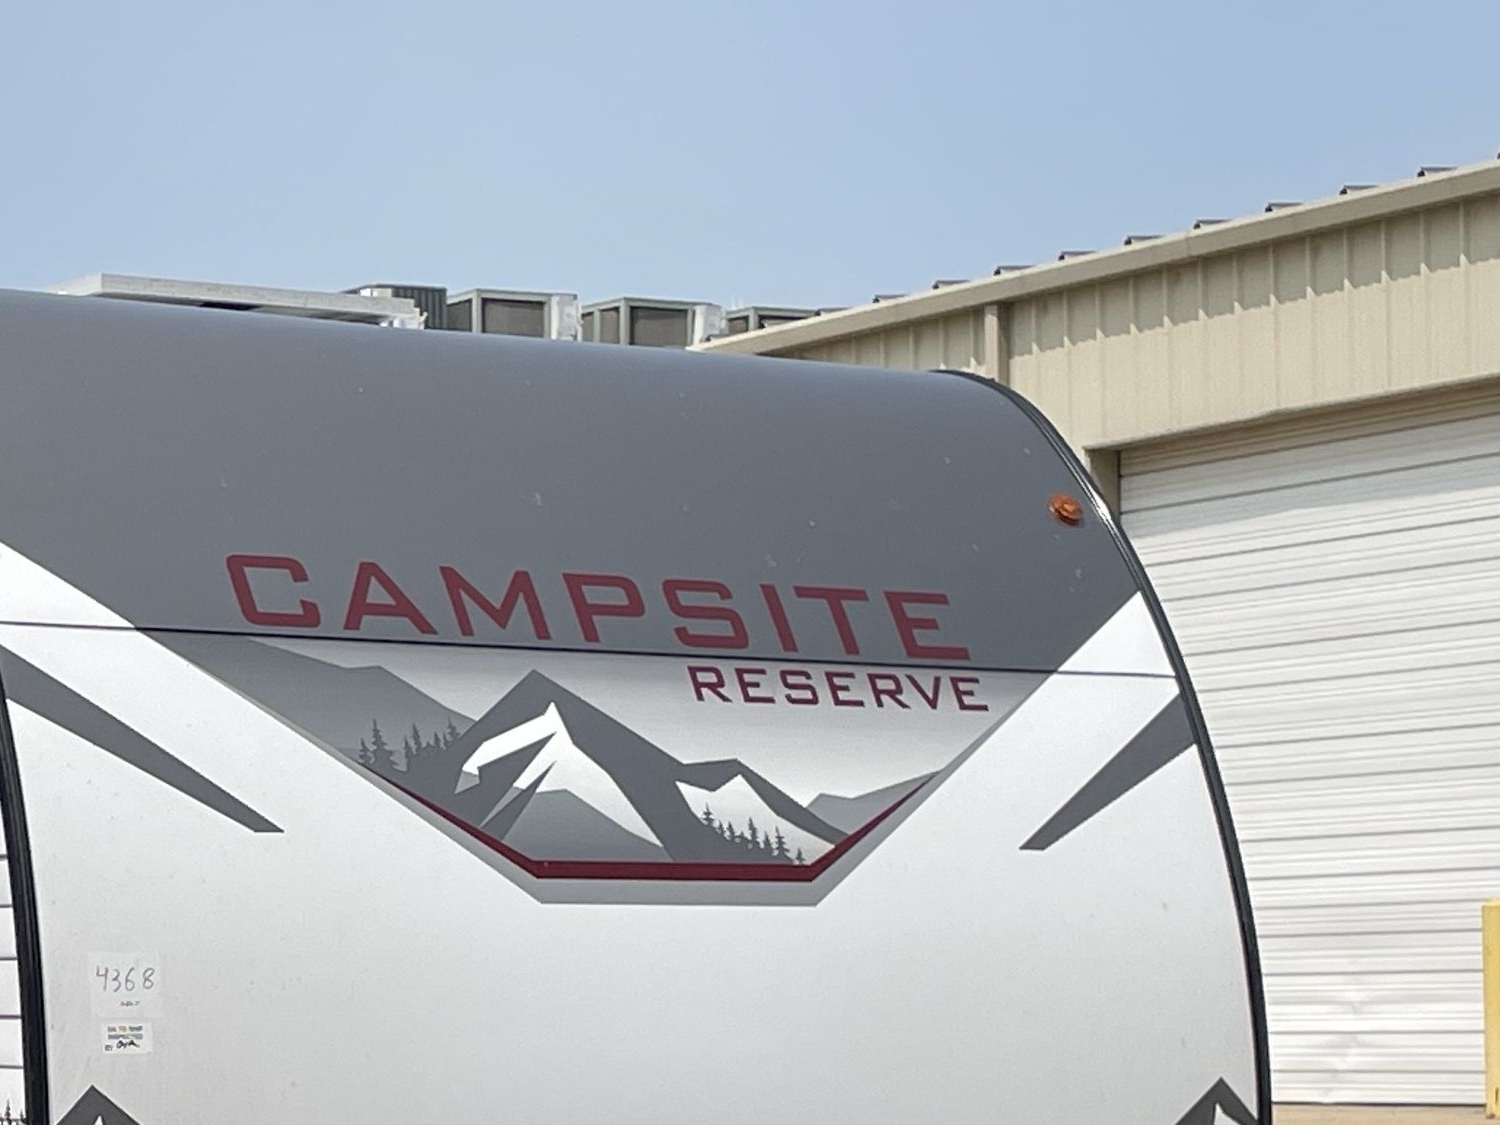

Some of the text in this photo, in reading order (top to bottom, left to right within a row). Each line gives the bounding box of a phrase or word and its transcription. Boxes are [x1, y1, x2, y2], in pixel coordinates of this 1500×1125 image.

[226, 554, 970, 660] CAMPSITE
[687, 665, 989, 712] RESERVE
[96, 965, 155, 992] 4368
